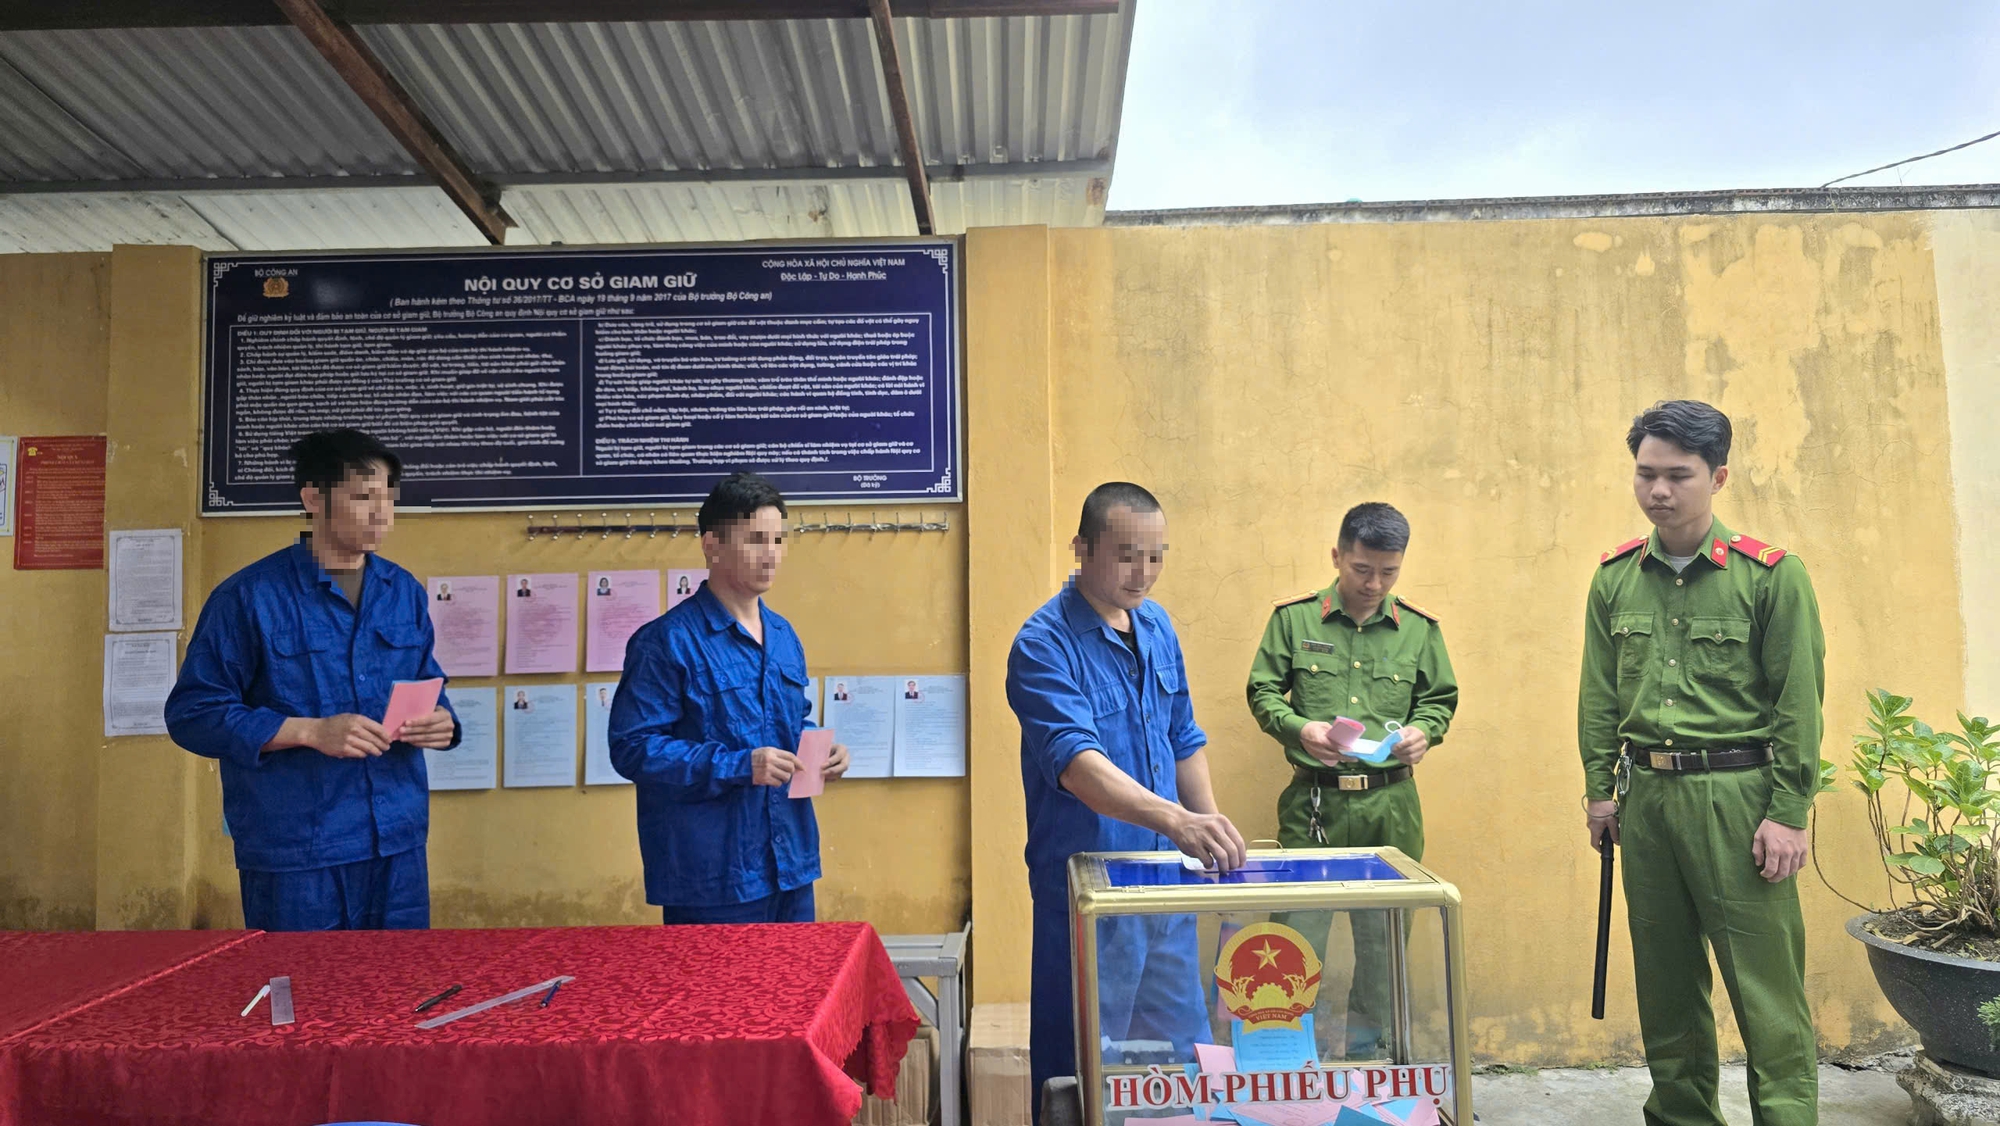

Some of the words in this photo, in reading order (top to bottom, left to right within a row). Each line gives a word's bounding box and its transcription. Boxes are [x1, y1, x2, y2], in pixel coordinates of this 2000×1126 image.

[761, 259, 785, 268] CỘNG
[786, 258, 803, 267] HÒA
[804, 258, 814, 267] XÃ
[815, 258, 829, 268] HỘI
[830, 257, 846, 266] CHỦ
[847, 257, 871, 266] NGHĨA
[872, 257, 886, 267] VIỆT
[254, 268, 264, 277] BỘ
[265, 268, 287, 276] CÔNG
[780, 272, 796, 281] Độc
[798, 272, 812, 281] Lập
[818, 271, 827, 281] Tự
[828, 271, 841, 280] Do
[846, 271, 866, 280] Hạnh
[867, 270, 886, 279] Phúc
[464, 275, 496, 294] NỘI
[502, 277, 541, 290] QUY
[547, 276, 573, 289] CƠ
[579, 271, 604, 289] SỞ
[609, 275, 658, 288] GIAM
[663, 272, 697, 287] GIỮ
[654, 292, 671, 301] 2017
[672, 292, 686, 301] của
[688, 292, 699, 302] Bộ
[700, 292, 725, 302] trưởng
[726, 291, 737, 301] Bộ
[738, 291, 758, 301] Công
[1111, 1066, 1212, 1107] HÒM
[1224, 1060, 1351, 1103] PHIẾU
[1365, 1066, 1450, 1105] PHỤ
